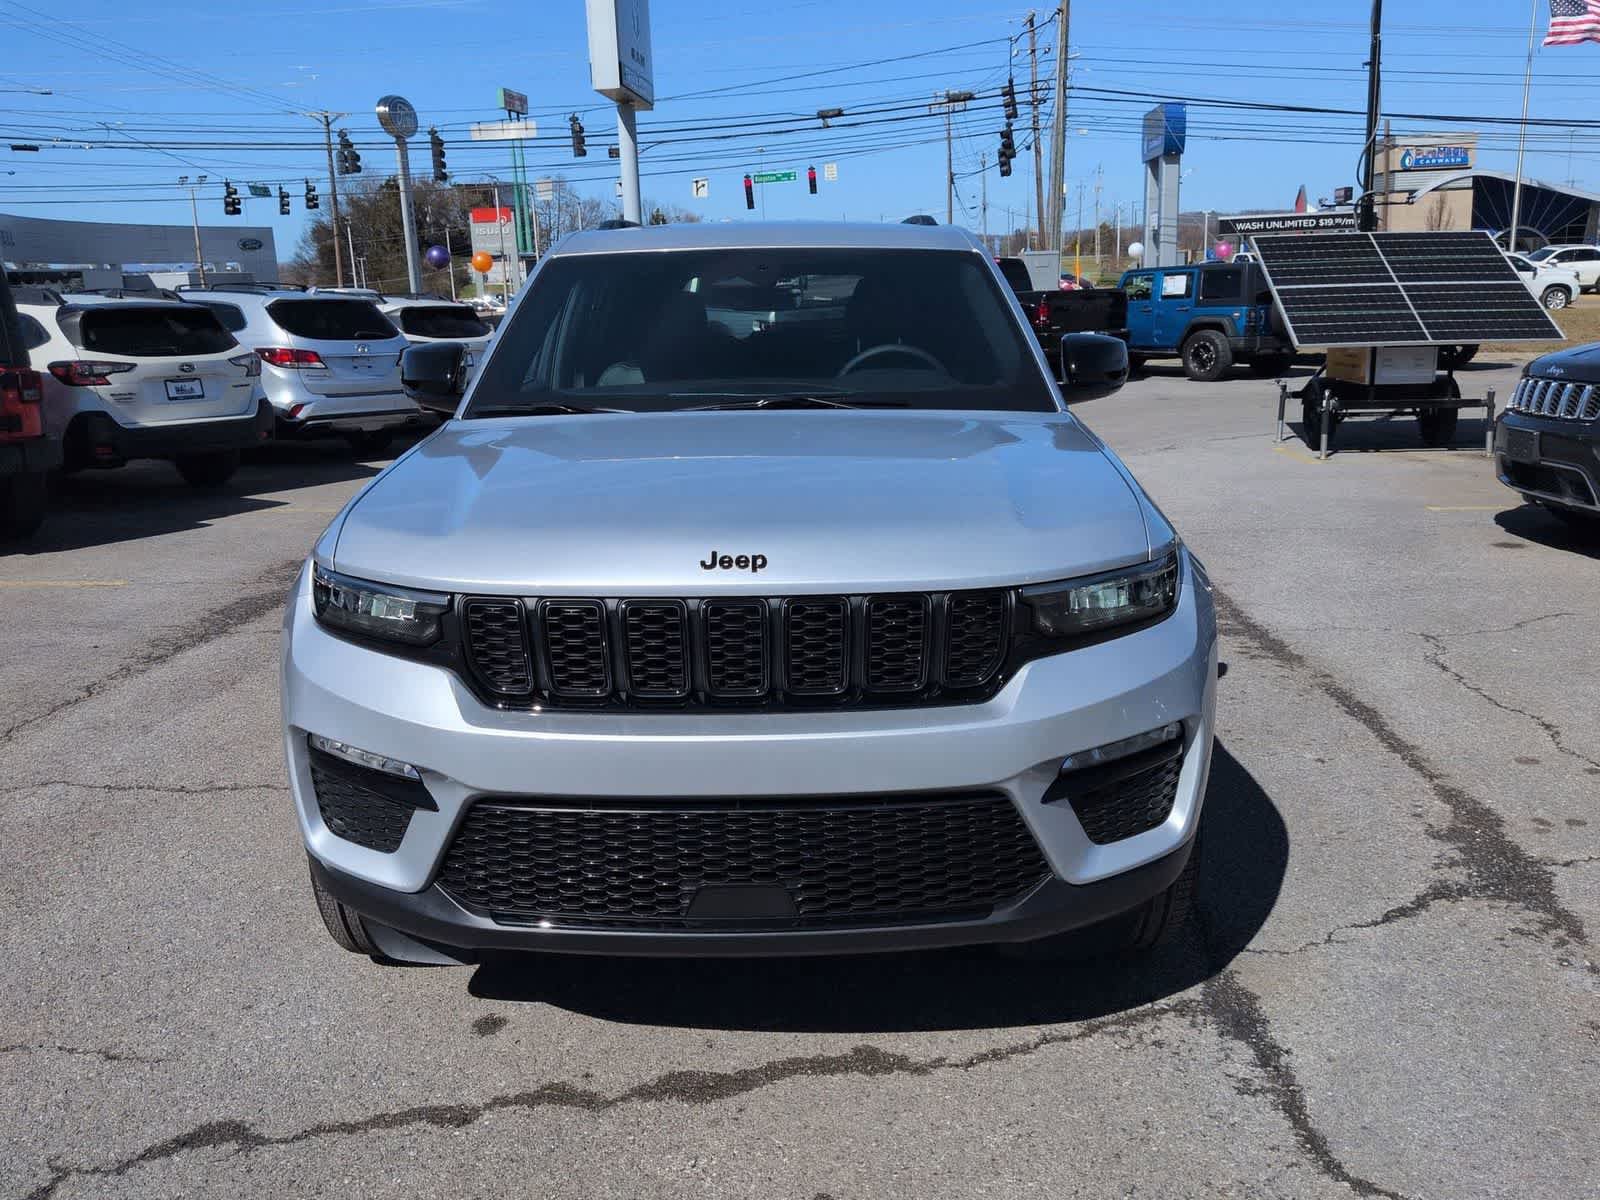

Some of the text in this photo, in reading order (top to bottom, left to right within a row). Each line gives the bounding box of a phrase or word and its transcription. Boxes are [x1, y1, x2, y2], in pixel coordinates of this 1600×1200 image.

[1236, 222, 1264, 231] WASH
[1265, 219, 1316, 230] UNLIMITED
[700, 551, 768, 573] Jeep
